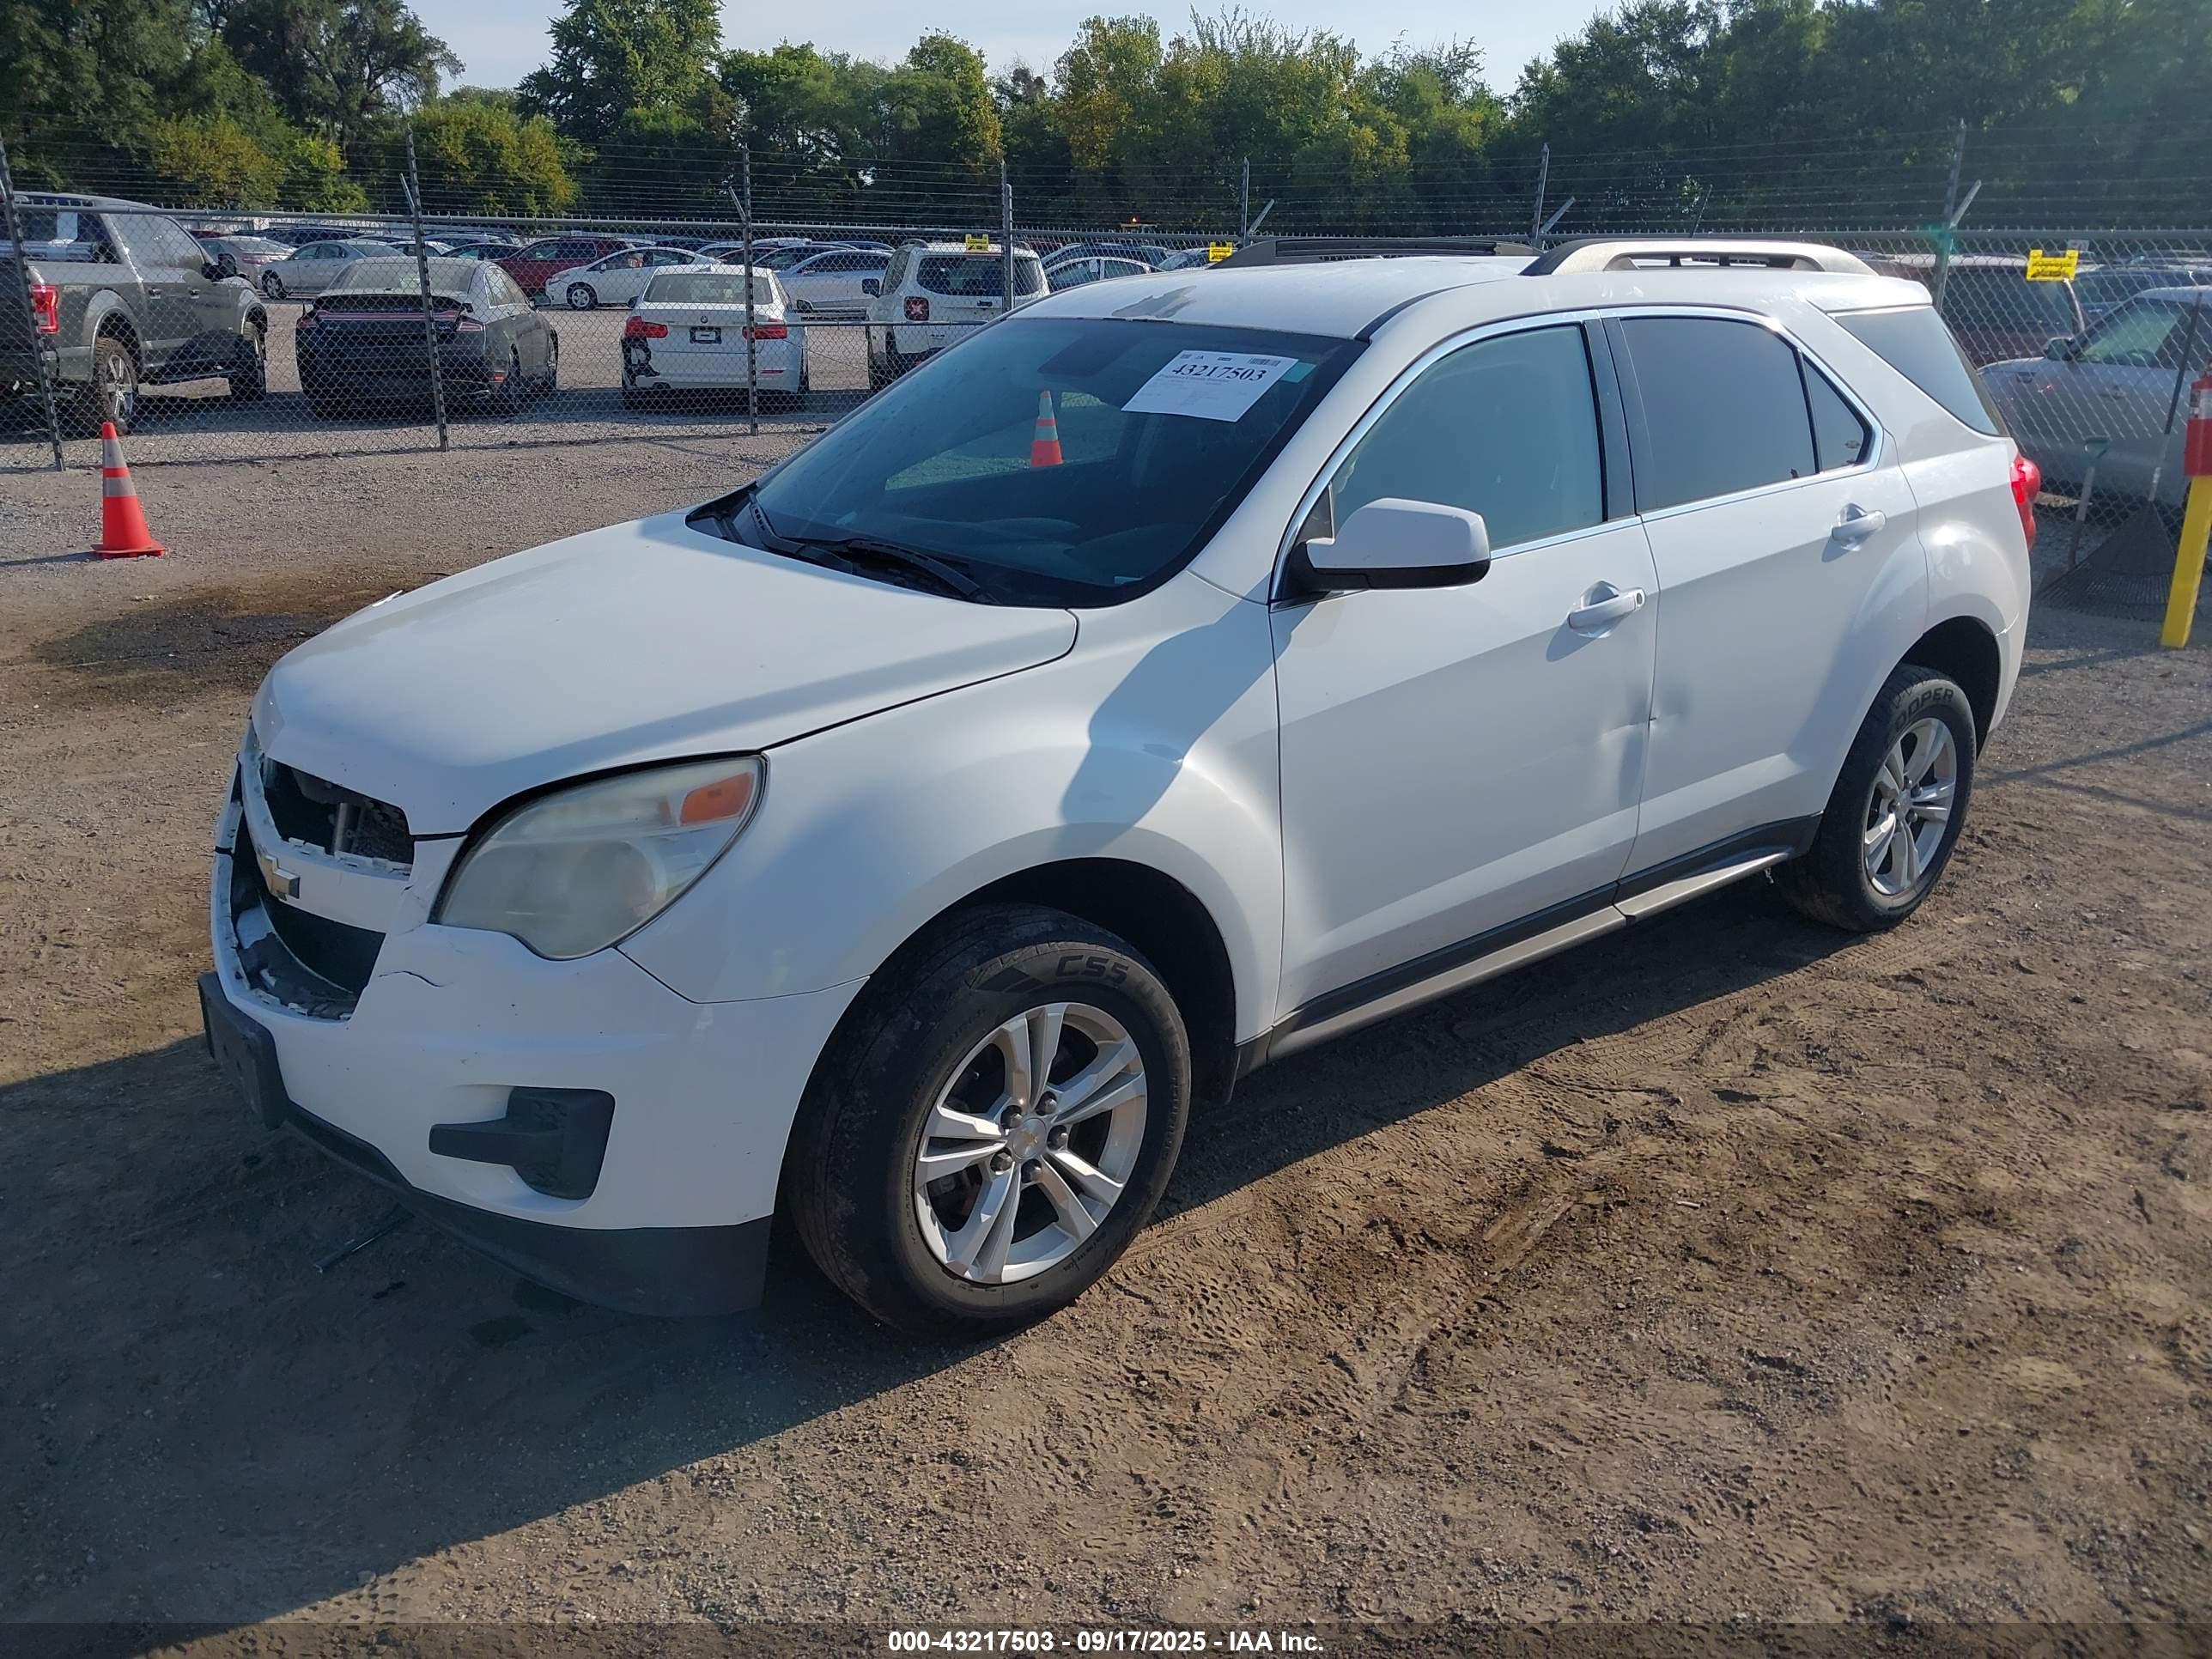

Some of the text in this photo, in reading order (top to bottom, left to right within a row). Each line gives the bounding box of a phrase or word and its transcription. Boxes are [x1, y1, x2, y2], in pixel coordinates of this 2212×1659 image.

[1171, 362, 1267, 382] 43217503
[1893, 686, 1954, 737] OOPER
[1055, 953, 1130, 985] CS5
